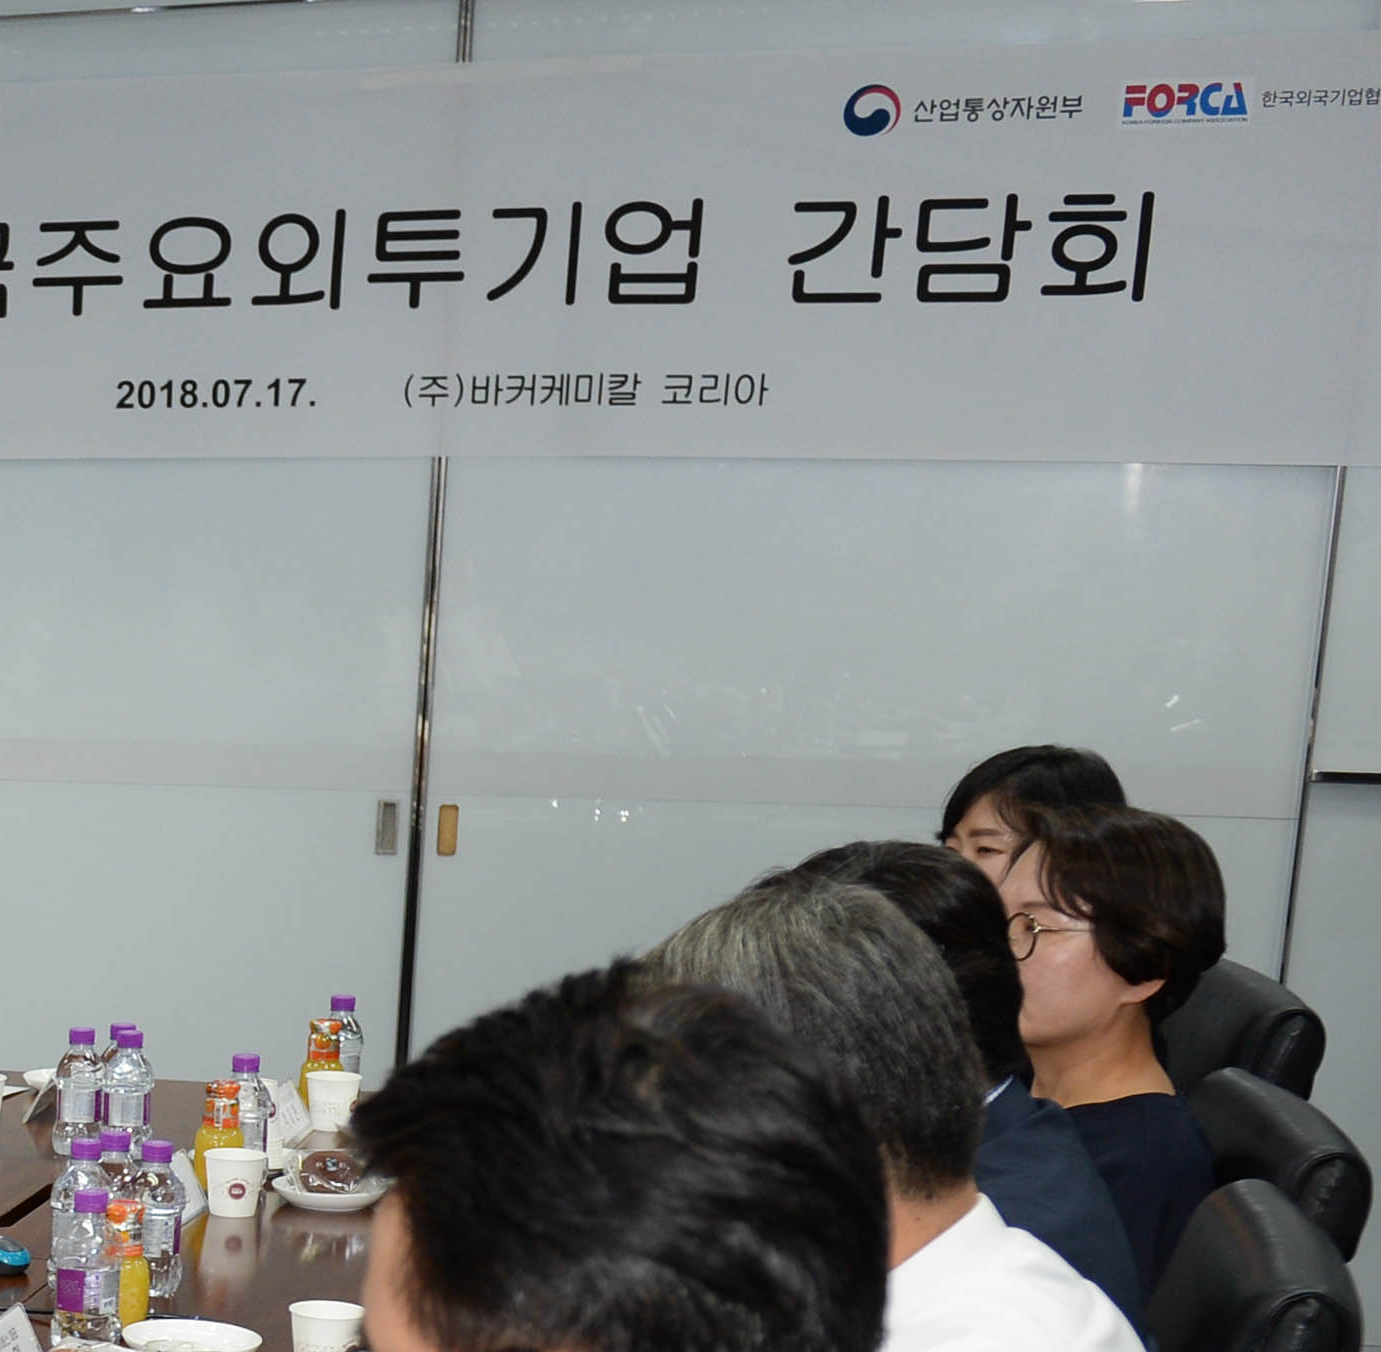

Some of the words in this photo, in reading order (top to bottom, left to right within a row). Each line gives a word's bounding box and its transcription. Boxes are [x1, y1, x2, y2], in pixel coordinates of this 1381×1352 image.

[913, 94, 1084, 123] 산업통상자원부
[1123, 82, 1249, 118] FORCA
[1261, 87, 1381, 108] 한국외국기업협
[786, 190, 1156, 304] 간담회
[116, 378, 317, 411] 2018.07.17.
[403, 371, 642, 409] (주)바커케미칼
[661, 372, 770, 407] 코리아
